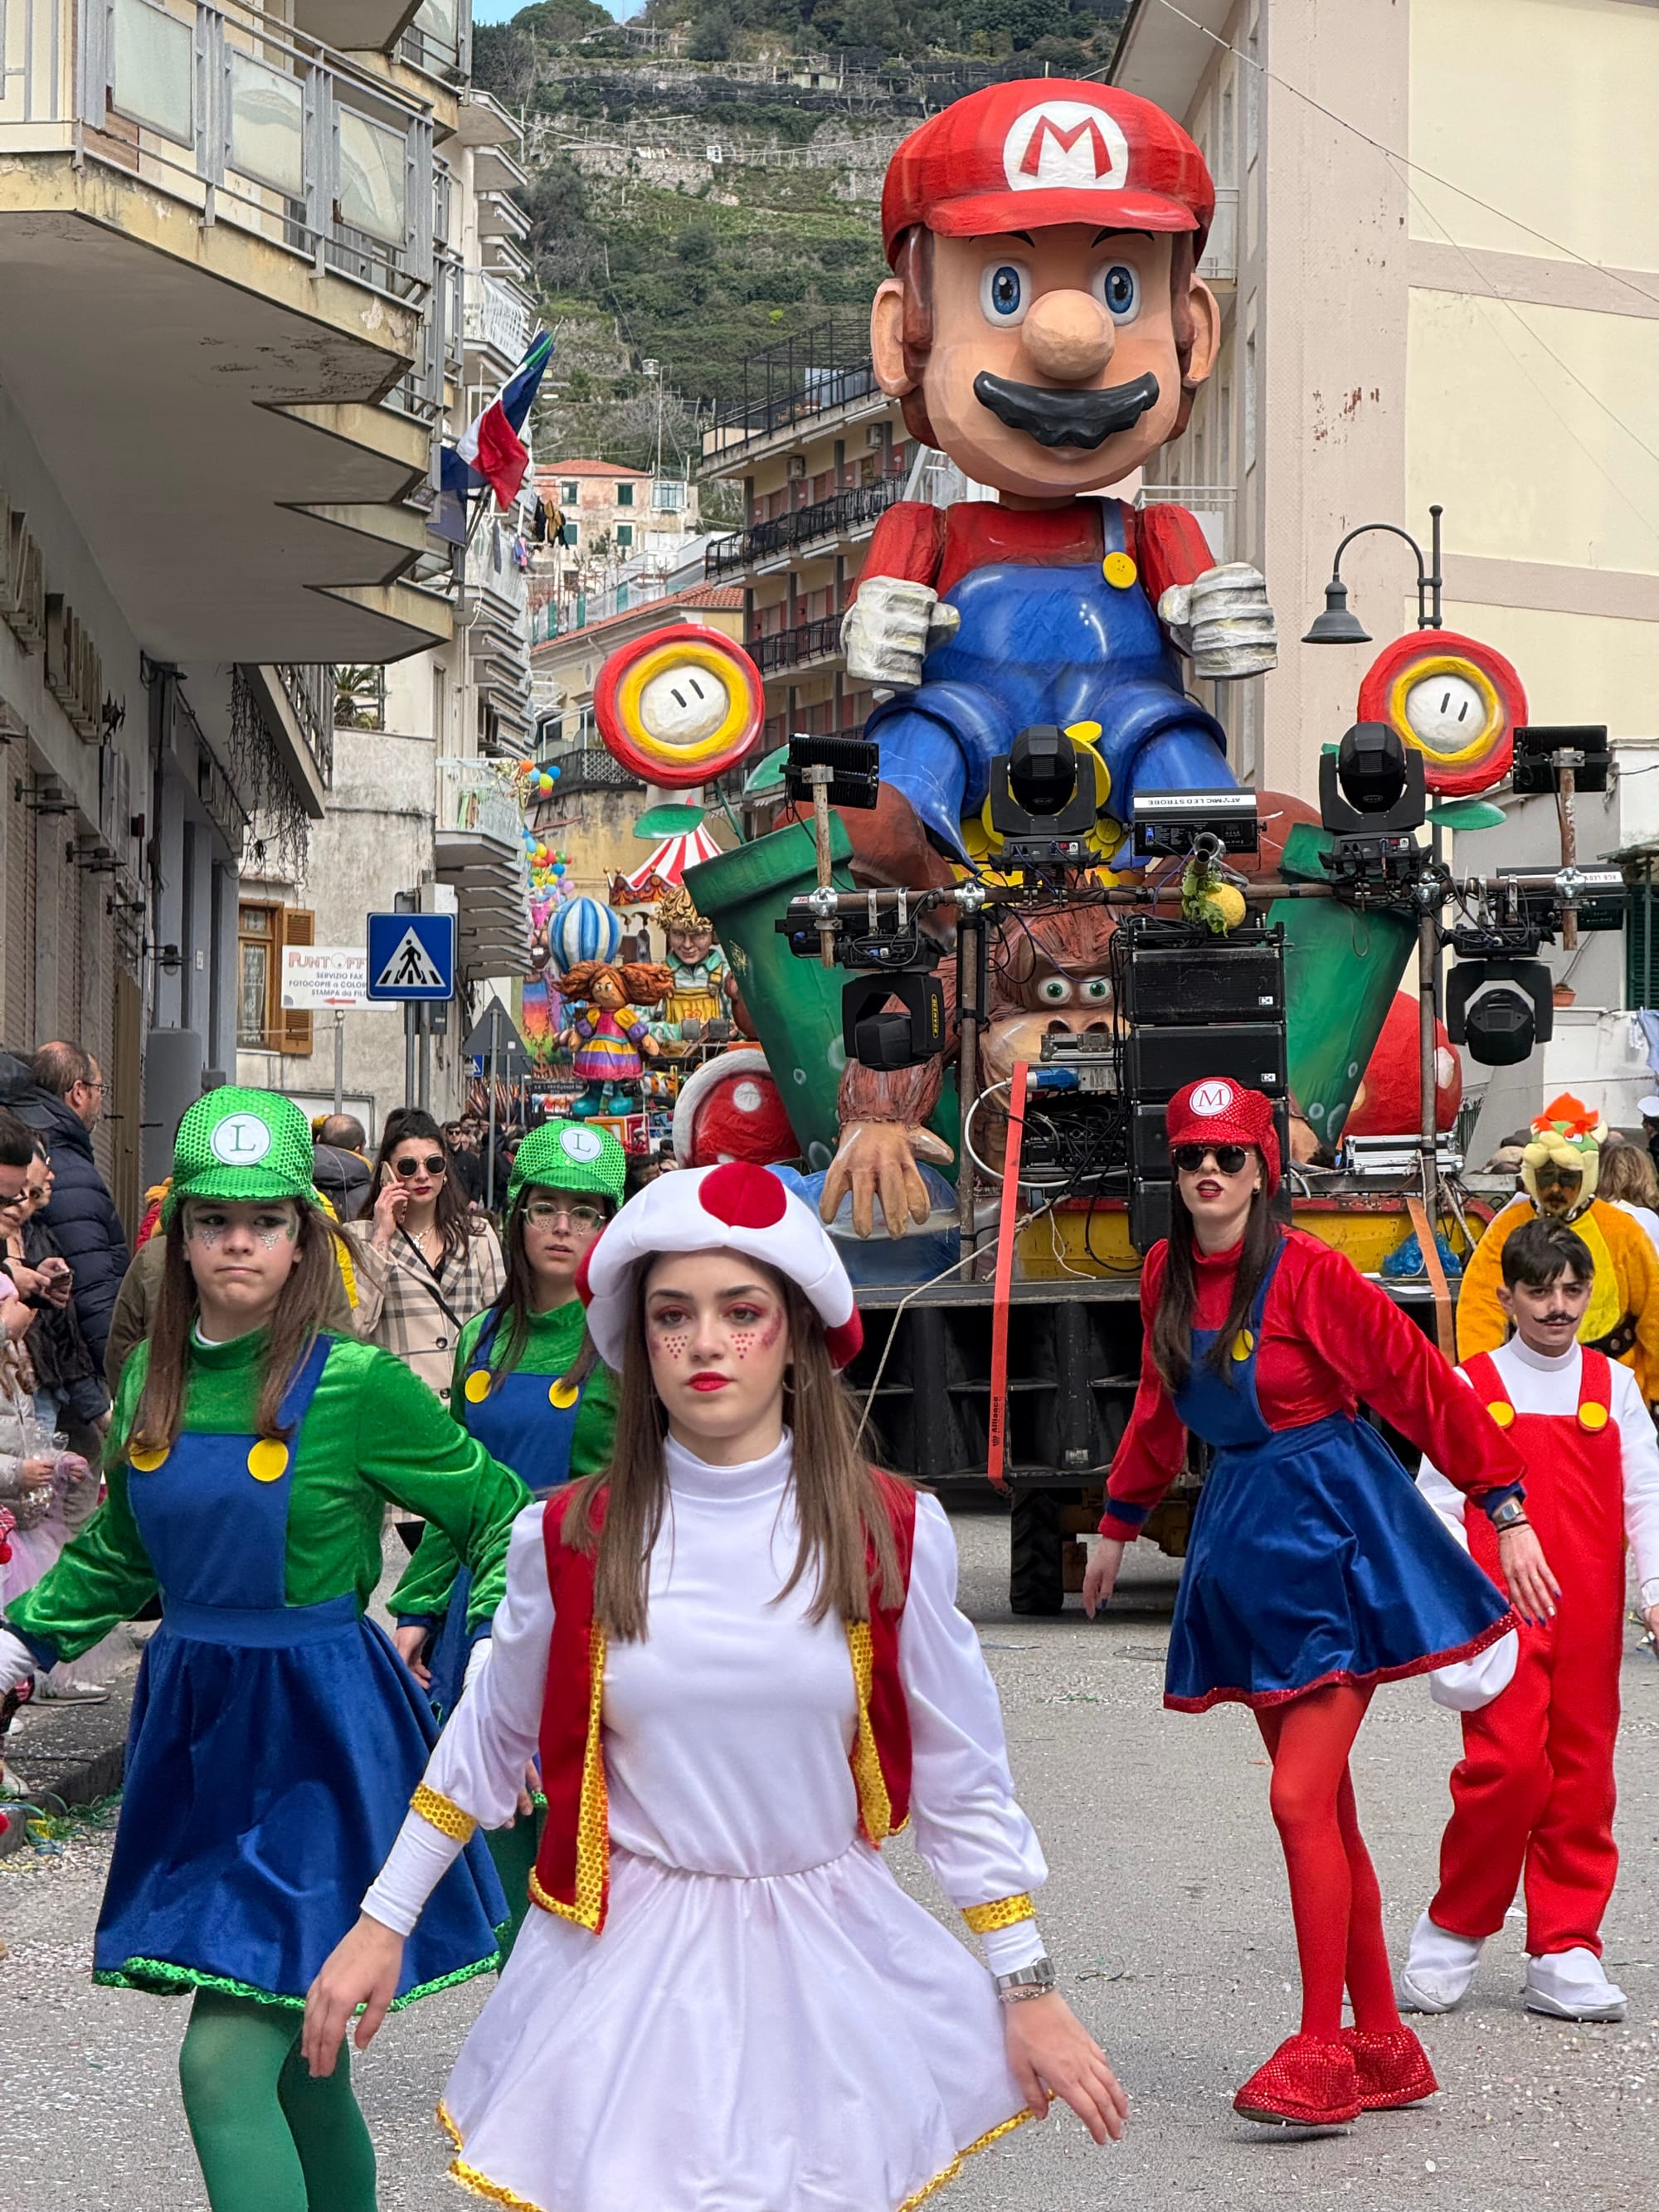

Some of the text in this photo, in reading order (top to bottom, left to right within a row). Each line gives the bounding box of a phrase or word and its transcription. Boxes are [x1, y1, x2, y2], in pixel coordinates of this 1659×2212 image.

[1019, 114, 1113, 179] M
[1196, 1088, 1225, 1107] M
[230, 1124, 256, 1152] L
[572, 1132, 591, 1153] L
[991, 1396, 1000, 1432] Alliance
